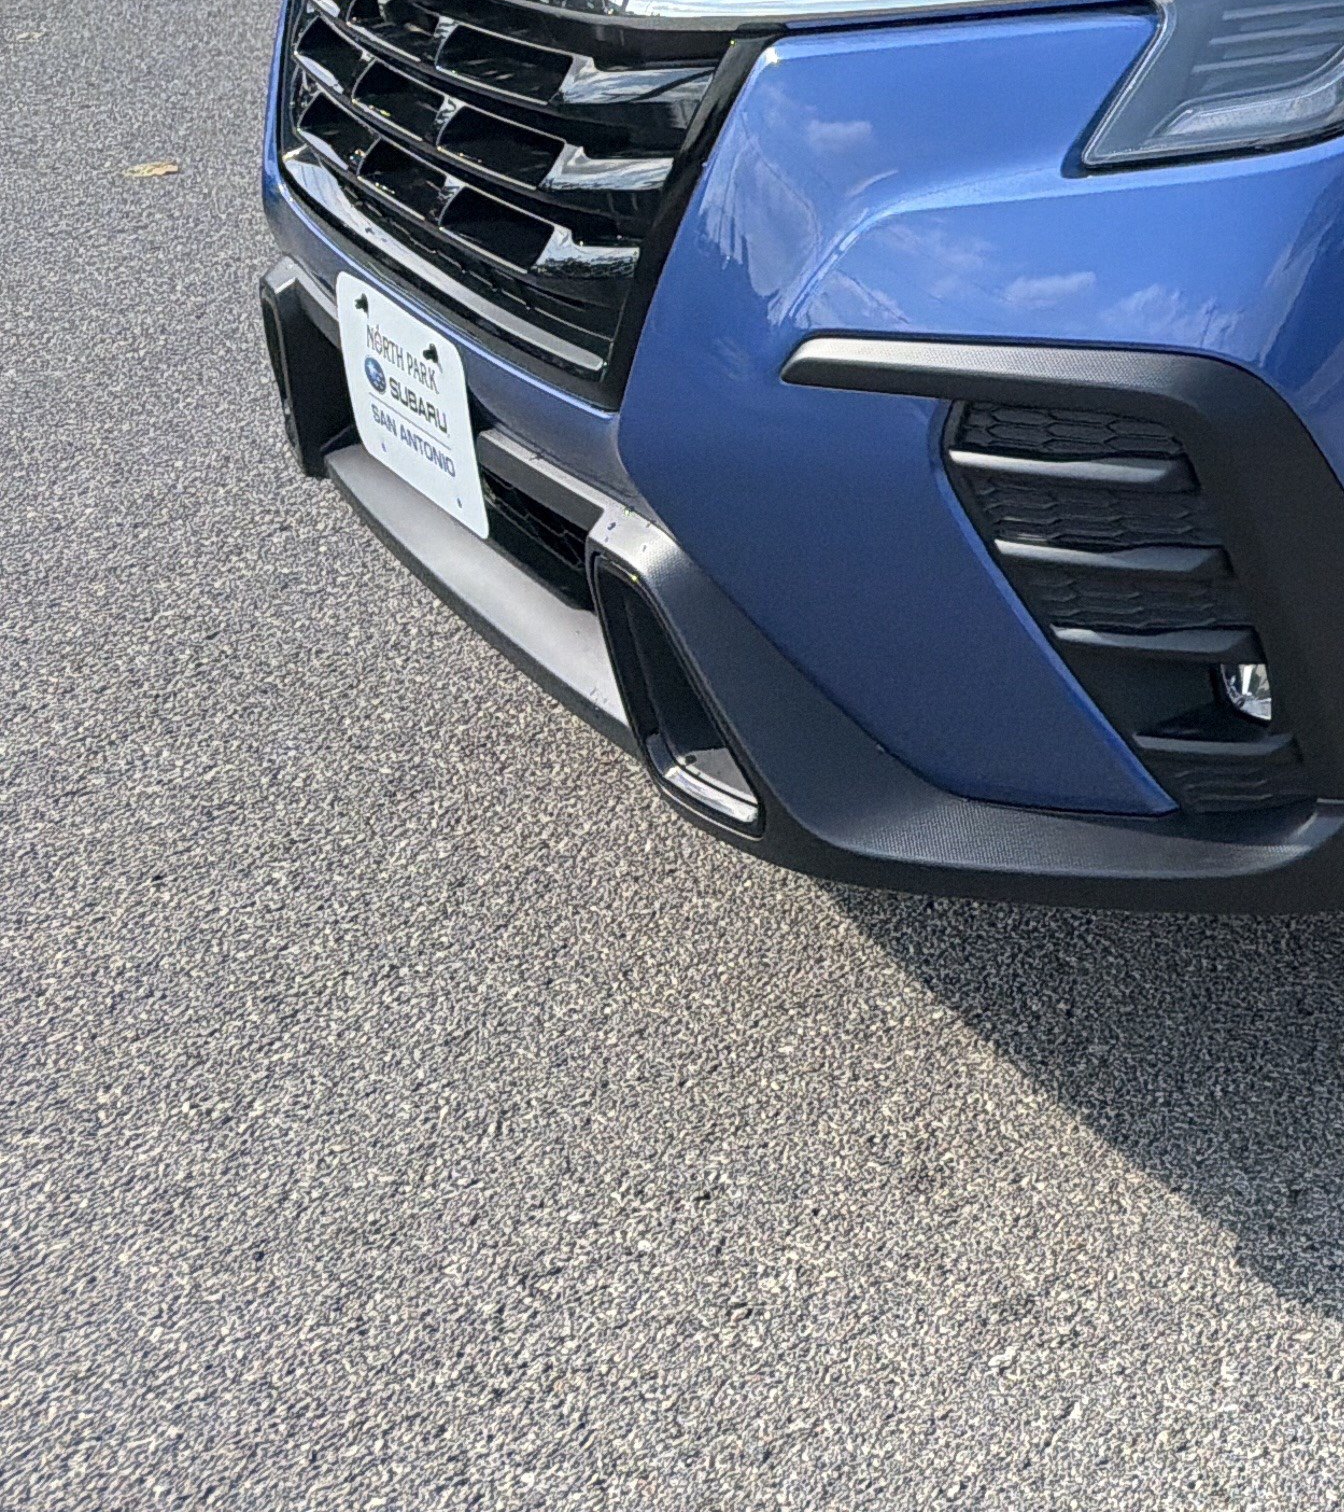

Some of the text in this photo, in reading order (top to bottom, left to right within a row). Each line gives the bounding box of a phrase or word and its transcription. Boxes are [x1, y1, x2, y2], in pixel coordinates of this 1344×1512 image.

[366, 323, 438, 393] NORTH PARK
[370, 402, 457, 478] SAN ANTONIO
[388, 376, 447, 435] SUBARU
